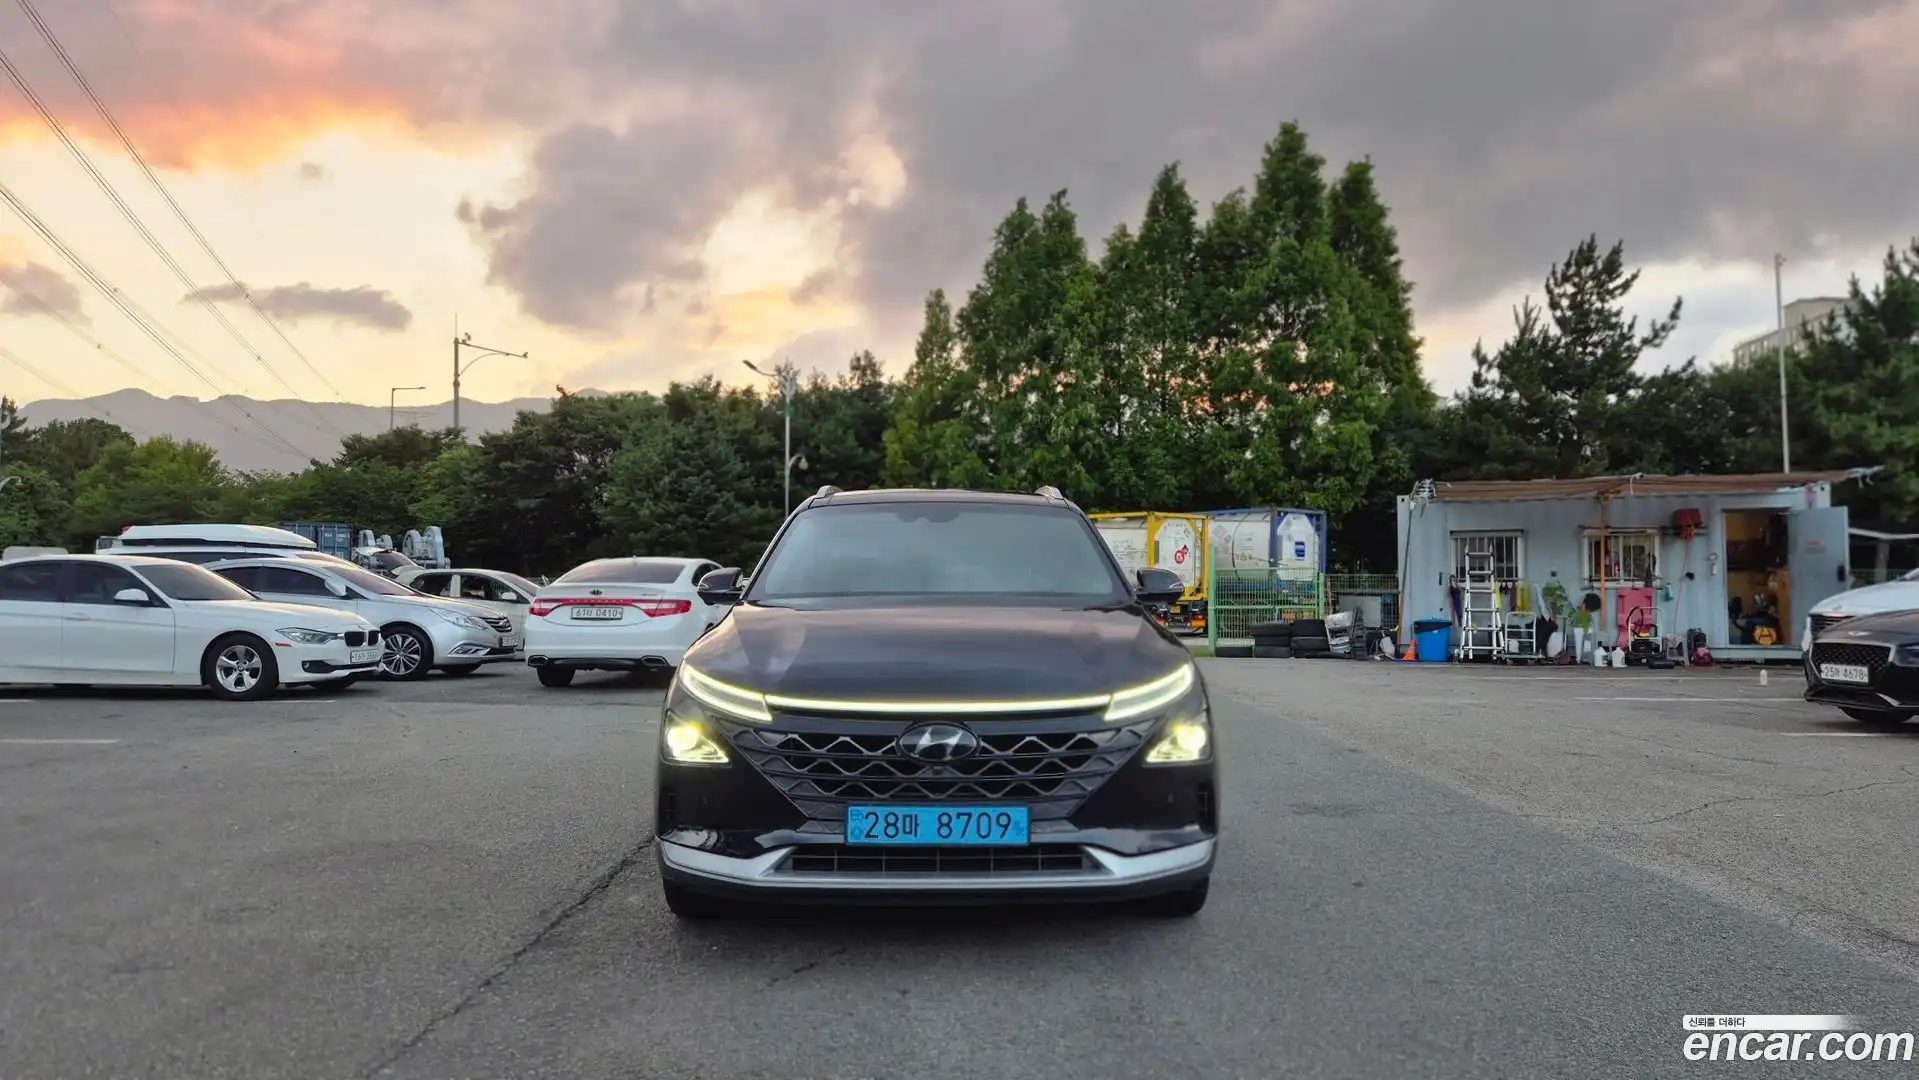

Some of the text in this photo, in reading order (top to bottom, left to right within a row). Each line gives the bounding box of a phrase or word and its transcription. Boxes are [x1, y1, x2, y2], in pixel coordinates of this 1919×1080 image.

[596, 608, 618, 617] 0410
[1843, 668, 1864, 681] 4678
[864, 811, 1012, 839] 28마 8709
